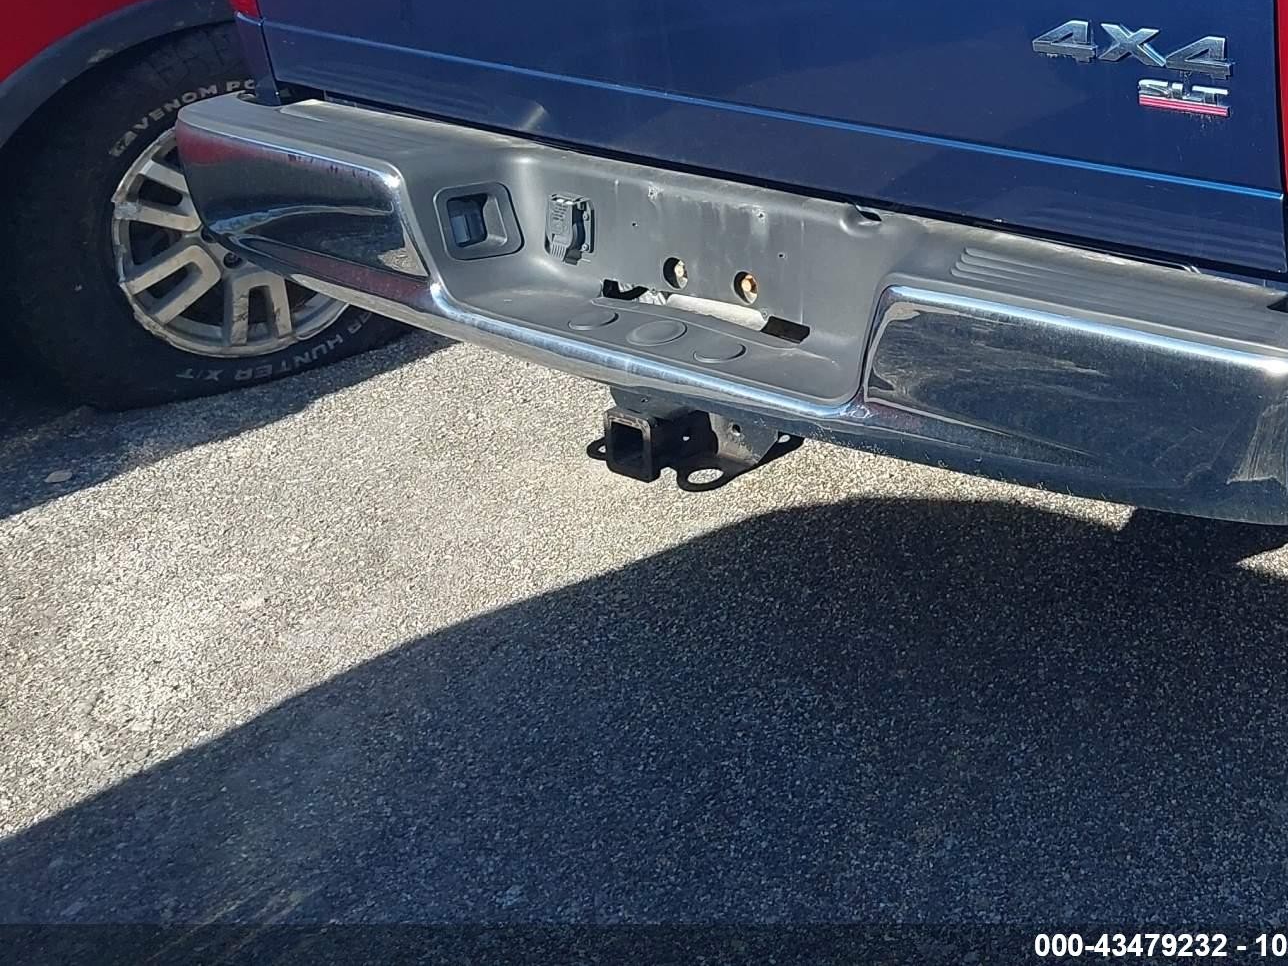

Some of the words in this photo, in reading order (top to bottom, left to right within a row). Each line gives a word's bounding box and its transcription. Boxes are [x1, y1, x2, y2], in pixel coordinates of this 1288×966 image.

[1031, 19, 1235, 80] 4X4
[1138, 78, 1230, 107] SLT
[233, 334, 345, 382] HUNTER
